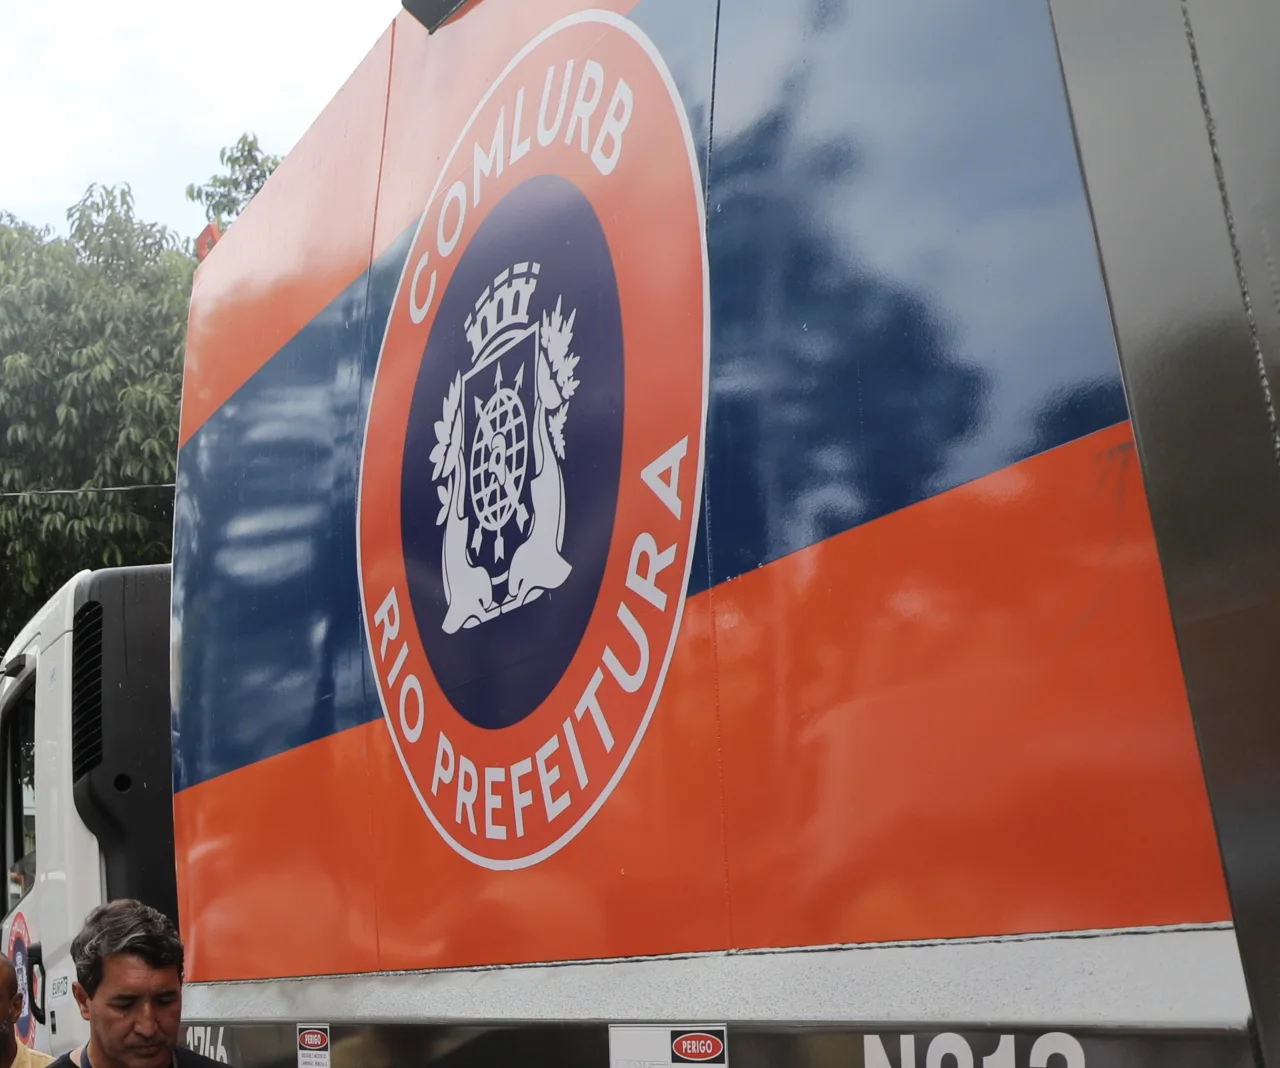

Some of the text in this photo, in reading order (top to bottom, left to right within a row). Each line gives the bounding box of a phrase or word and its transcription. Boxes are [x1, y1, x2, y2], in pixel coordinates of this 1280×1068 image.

[409, 59, 634, 325] COMLURB
[374, 435, 689, 841] RIO PREFEITURA
[304, 1033, 322, 1045] PERIGO
[682, 1040, 713, 1054] PERIGO
